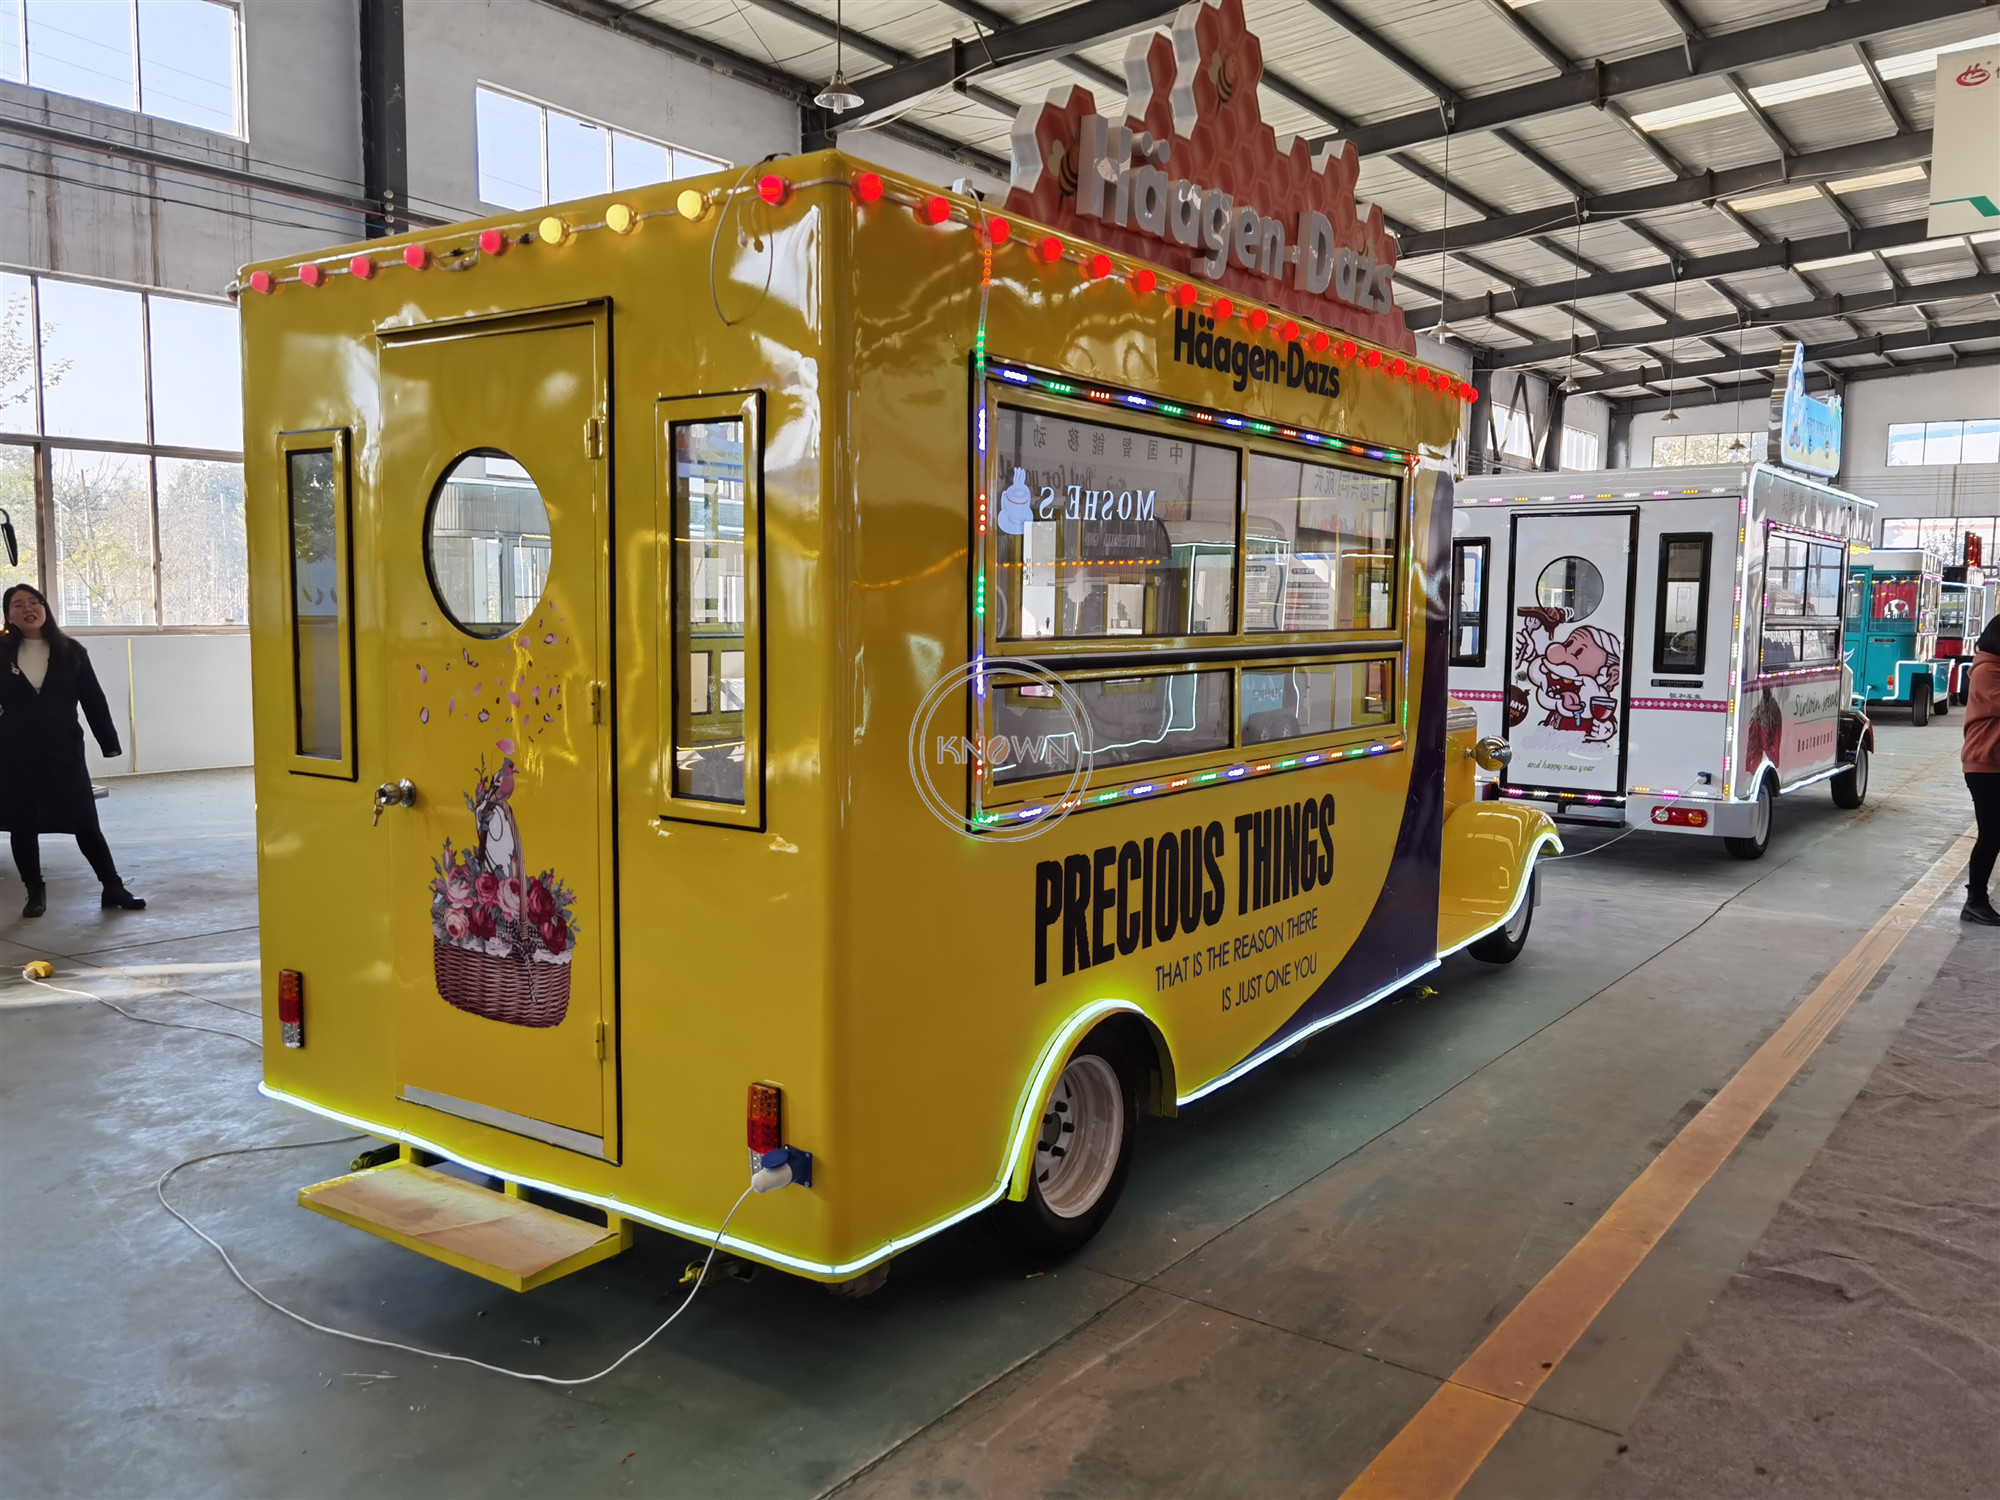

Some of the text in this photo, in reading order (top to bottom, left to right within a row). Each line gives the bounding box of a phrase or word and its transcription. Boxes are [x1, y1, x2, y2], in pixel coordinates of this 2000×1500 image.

[1527, 760, 1541, 769] and
[1541, 760, 1563, 771] happy
[1035, 793, 1336, 986] PRECIOUS THINGS
[1155, 908, 1319, 992] THAT IS THE REASON THERE
[1221, 953, 1319, 1013] IS JUST ONE YOU
